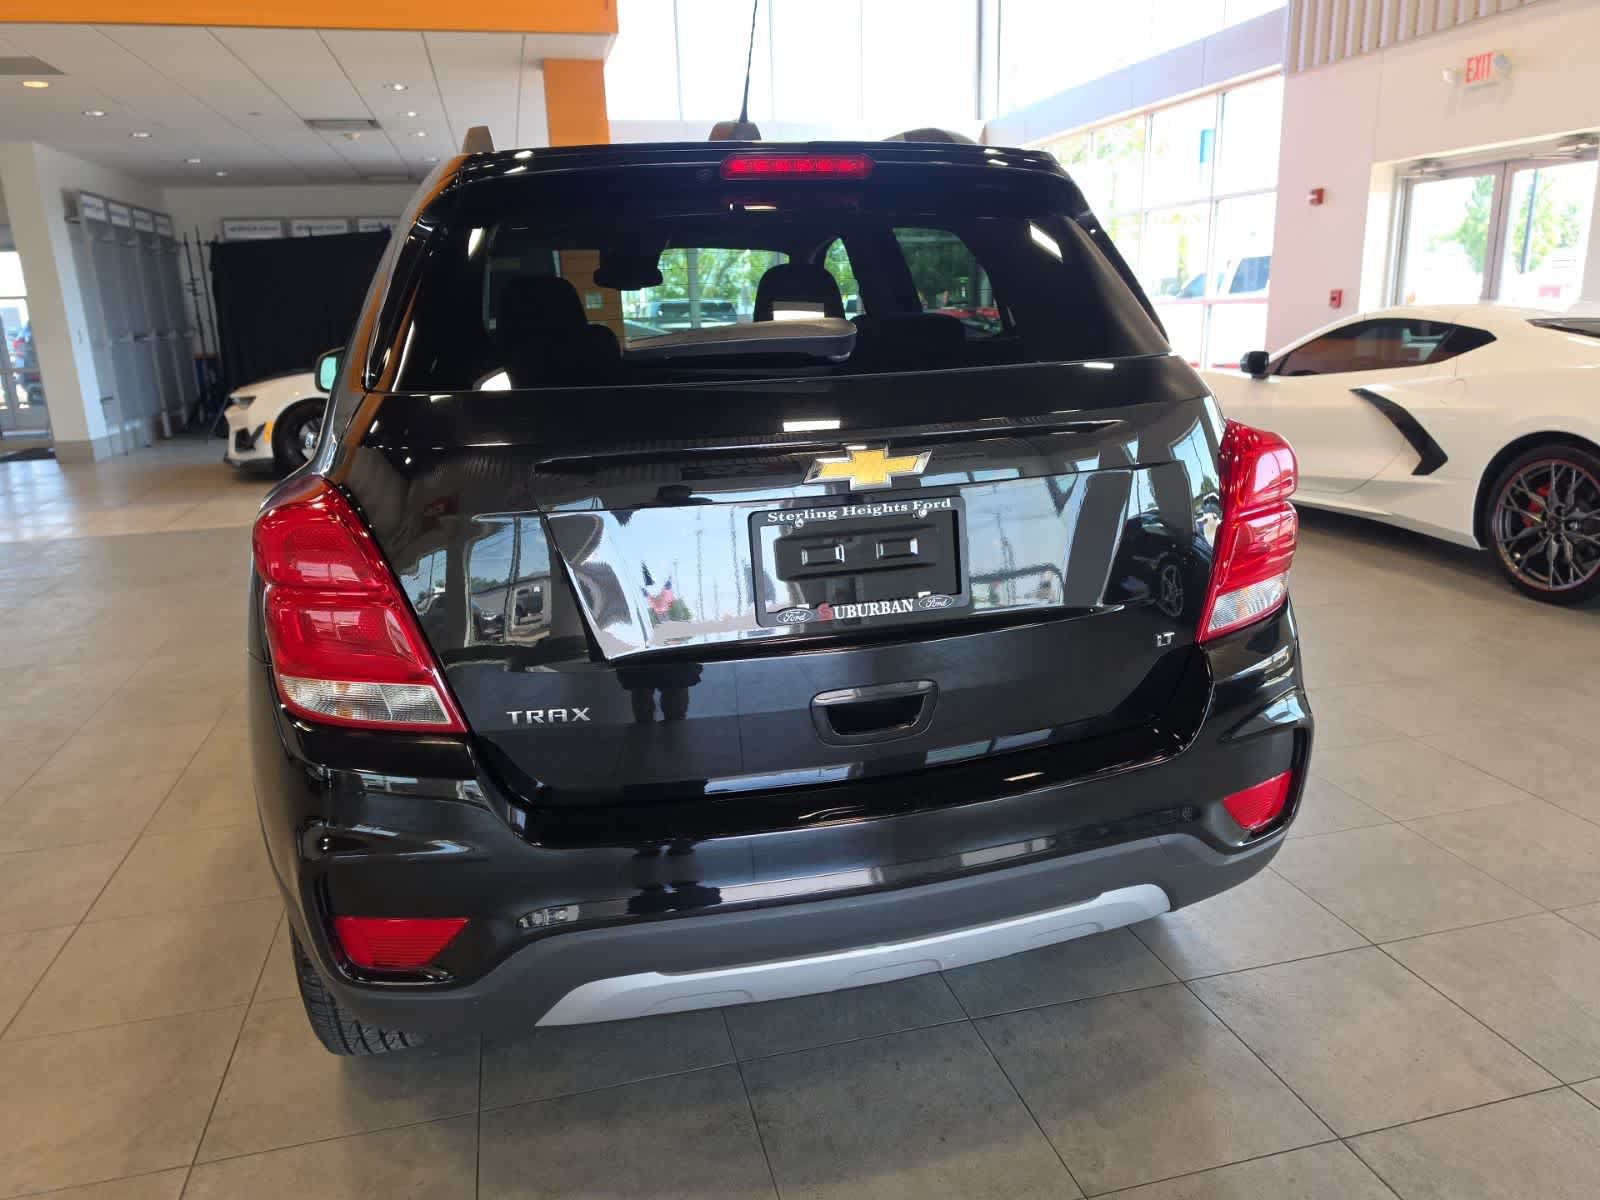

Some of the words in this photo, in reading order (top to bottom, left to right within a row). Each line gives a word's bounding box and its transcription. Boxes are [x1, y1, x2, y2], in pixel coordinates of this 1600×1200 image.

[1465, 51, 1494, 83] EXIT
[767, 508, 838, 523] Sterling
[841, 503, 908, 517] Heights
[912, 498, 952, 511] Ford
[817, 599, 914, 623] SUBURBAN
[923, 597, 949, 608] Ford
[781, 610, 811, 622] Ford
[1157, 631, 1175, 647] LT
[506, 707, 591, 725] TRAX
